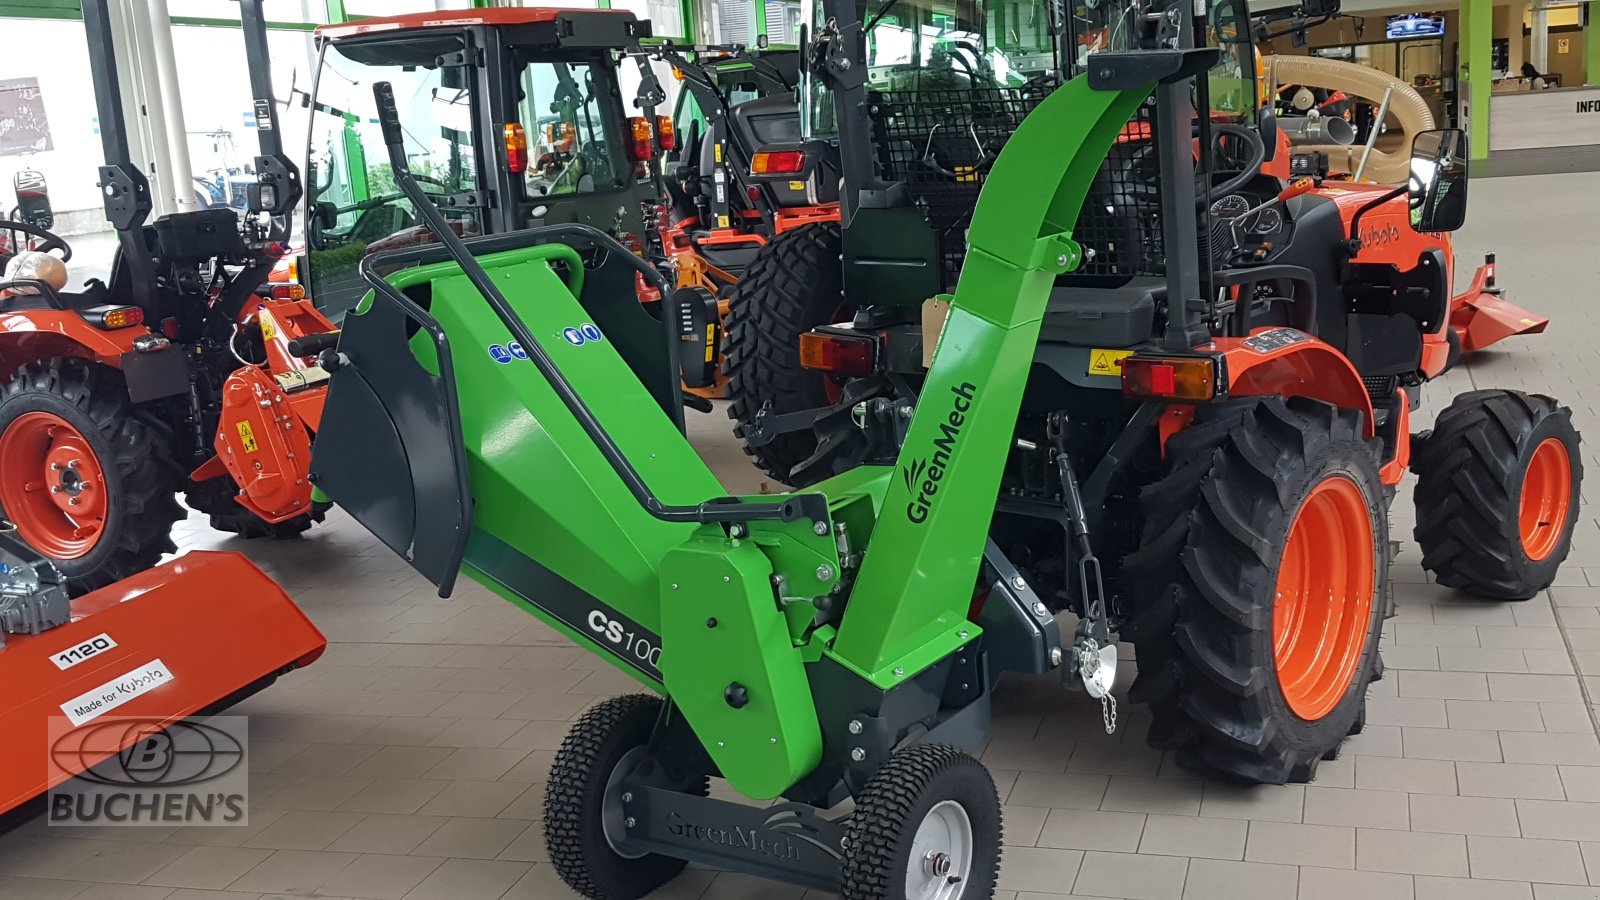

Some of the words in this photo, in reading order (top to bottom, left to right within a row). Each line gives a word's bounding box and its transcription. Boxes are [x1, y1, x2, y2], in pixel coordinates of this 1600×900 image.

[1576, 100, 1600, 113] INFO
[906, 381, 977, 524] GreenMech
[59, 638, 110, 664] 1120
[74, 699, 103, 717] Made
[102, 692, 117, 704] for
[115, 670, 164, 694] Kubota
[665, 811, 801, 861] GreenMech
